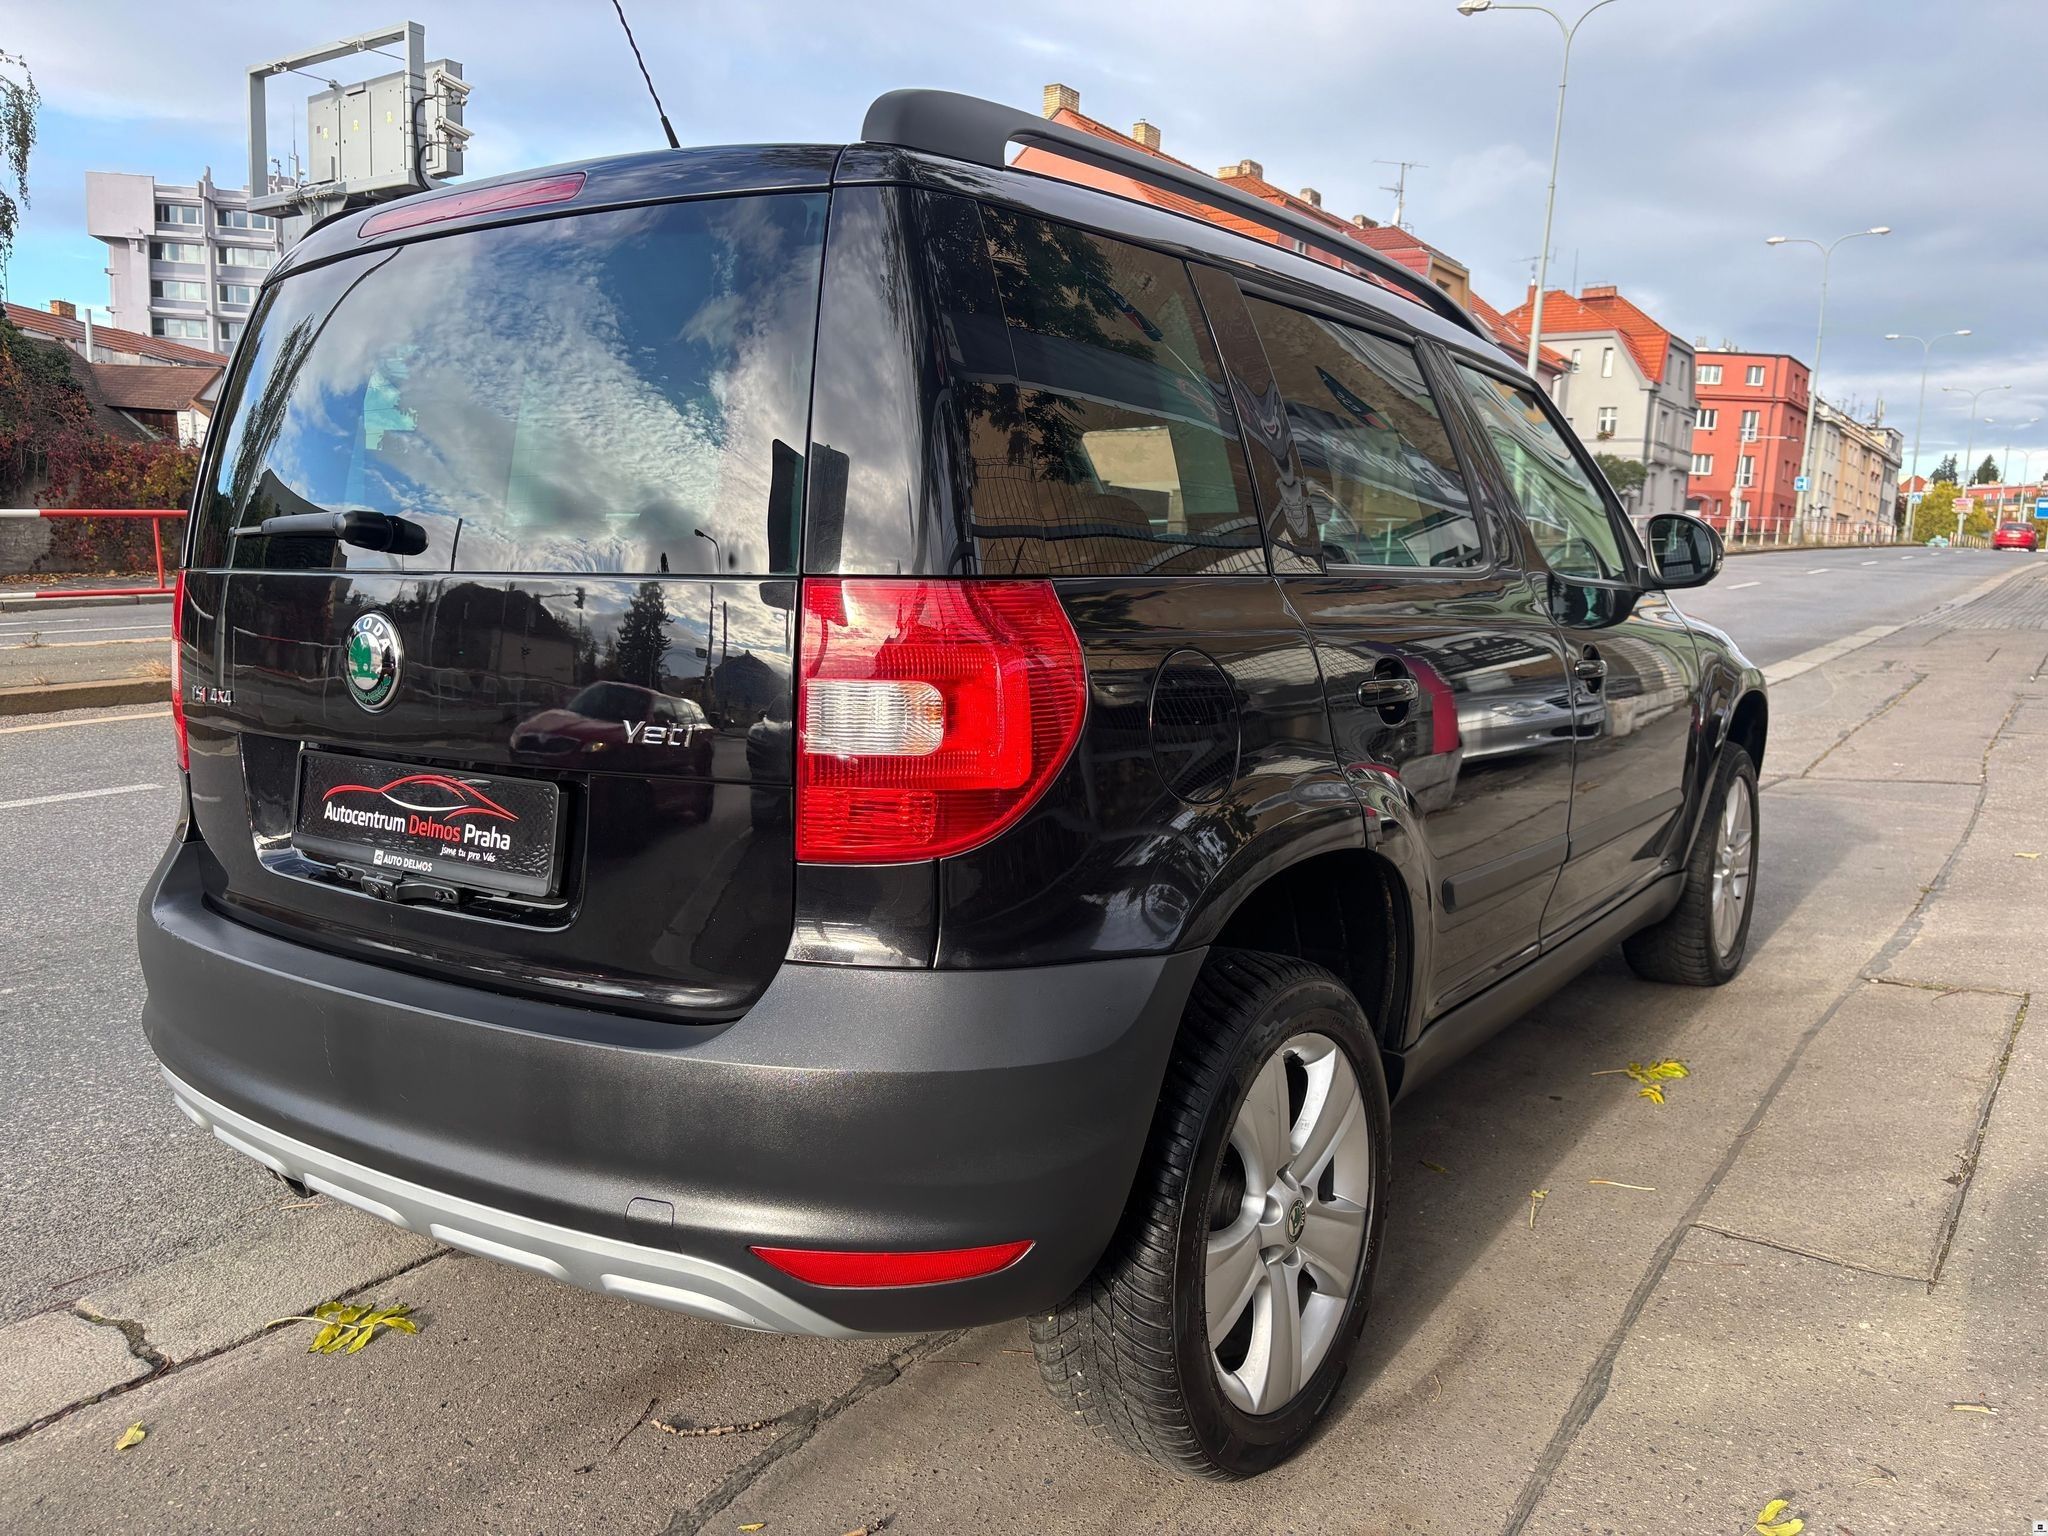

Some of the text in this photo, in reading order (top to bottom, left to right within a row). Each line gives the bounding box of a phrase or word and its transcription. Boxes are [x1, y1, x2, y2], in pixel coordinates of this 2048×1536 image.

[623, 719, 695, 748] Yeti
[323, 801, 511, 850] Autocentrum Delmos Praha
[383, 855, 433, 873] AUTO DELMOS
[440, 844, 457, 856] jsme
[458, 849, 467, 857] tu
[467, 852, 481, 861] pro
